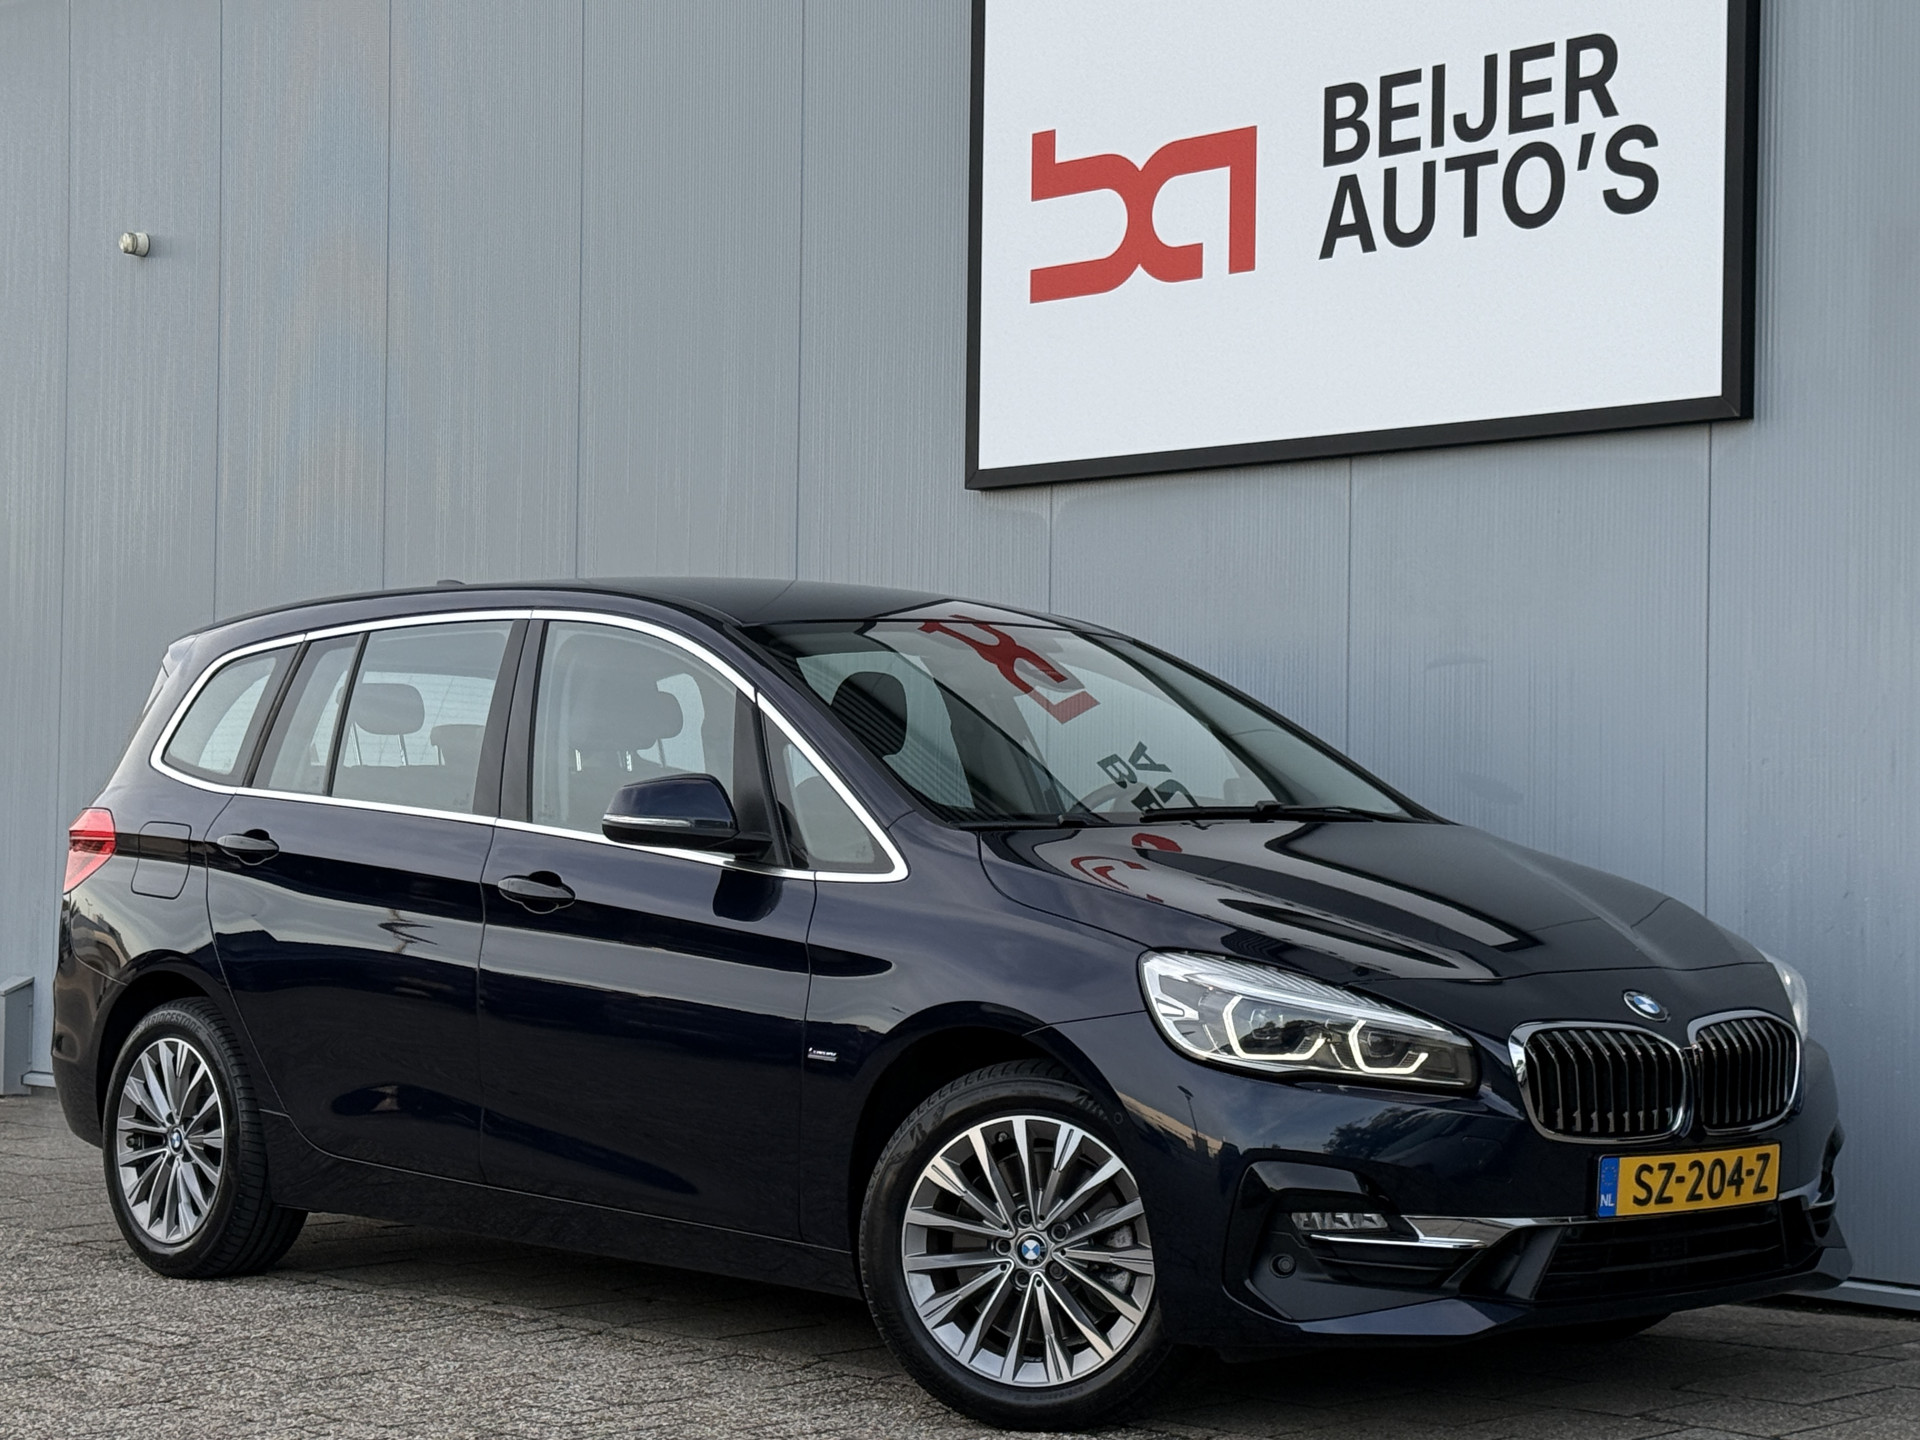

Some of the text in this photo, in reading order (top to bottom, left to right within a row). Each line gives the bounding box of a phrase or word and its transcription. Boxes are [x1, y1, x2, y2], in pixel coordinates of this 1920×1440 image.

[1323, 33, 1619, 168] BEIJER
[1318, 123, 1659, 260] AUTO'S
[1599, 1193, 1616, 1208] NL
[1632, 1152, 1772, 1207] SZ-204-Z
